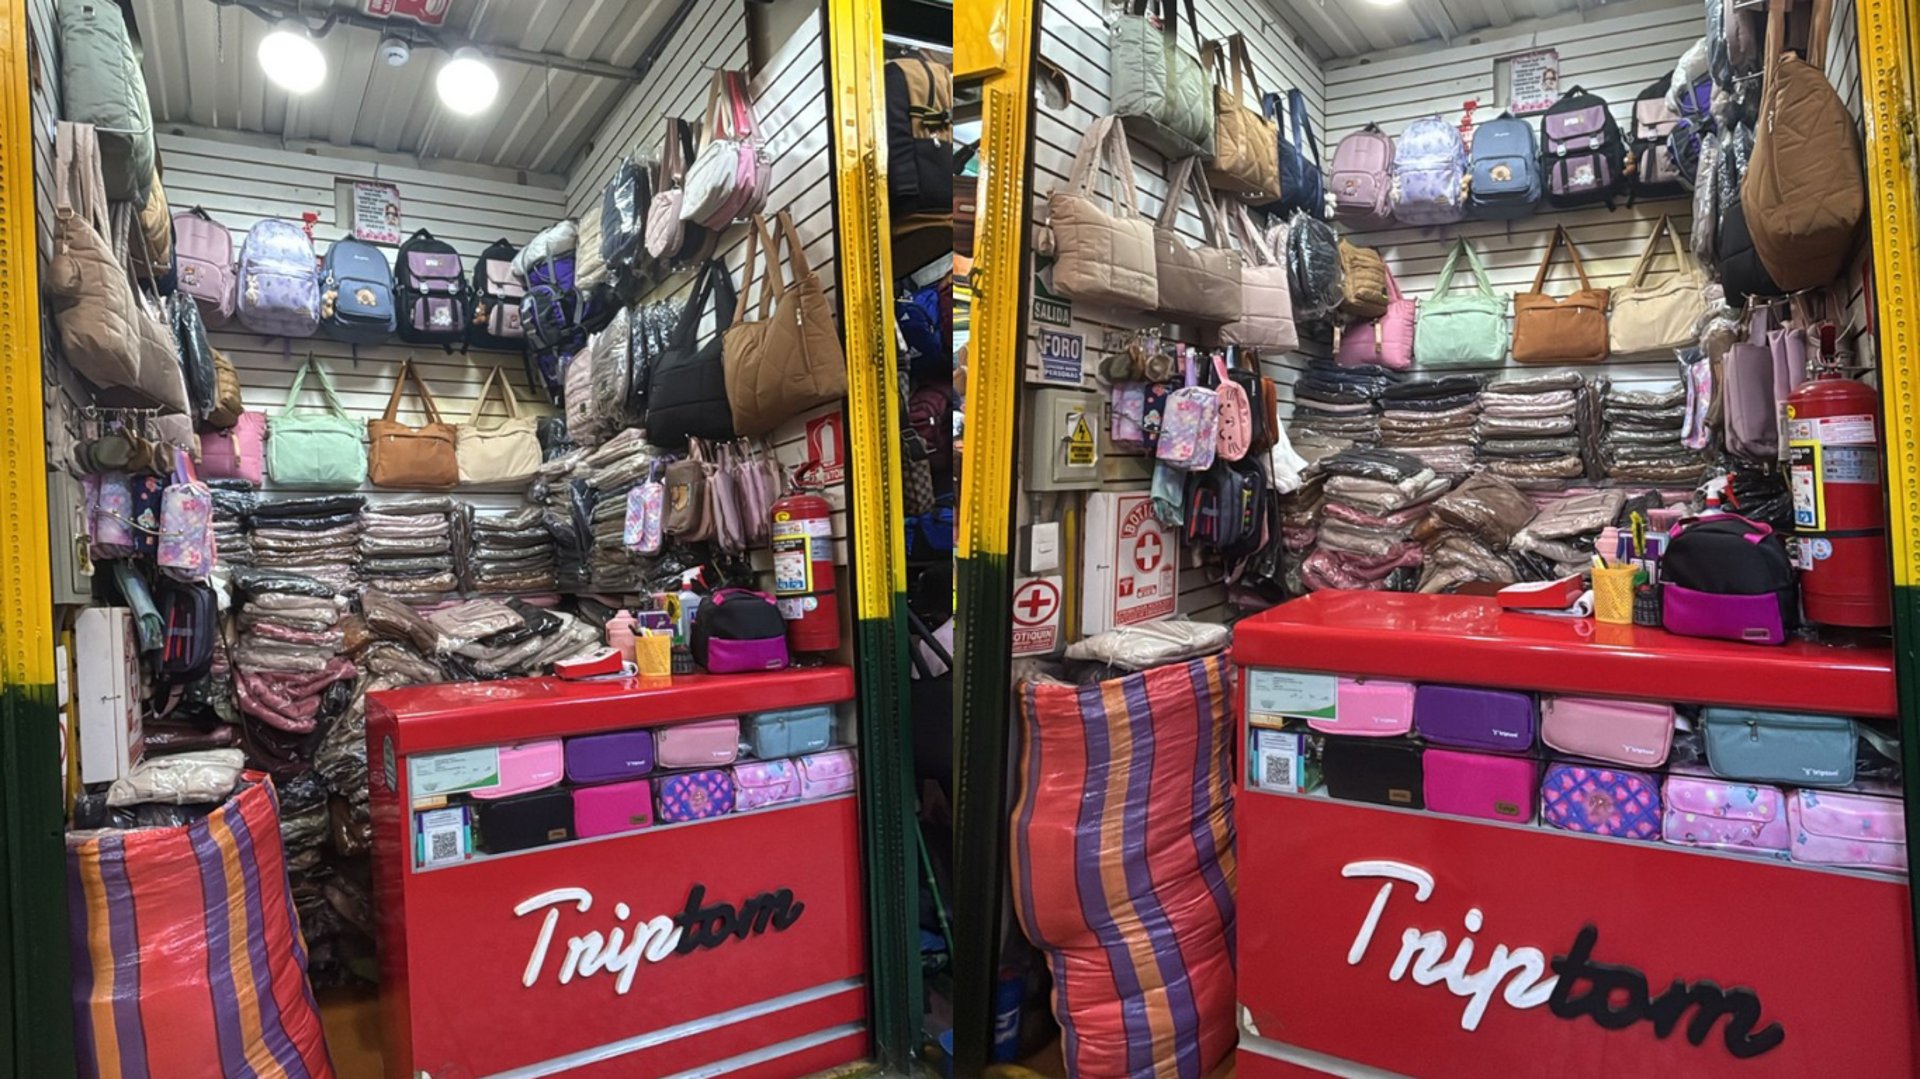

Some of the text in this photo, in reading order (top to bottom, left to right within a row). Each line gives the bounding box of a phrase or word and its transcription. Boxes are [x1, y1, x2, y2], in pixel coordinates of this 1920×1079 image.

[1034, 301, 1070, 325] SALIDA
[1041, 333, 1080, 359] FORO
[1013, 630, 1052, 642] OTIQUIN
[513, 882, 805, 995] Triptom
[1341, 858, 1786, 1059] Triptom
